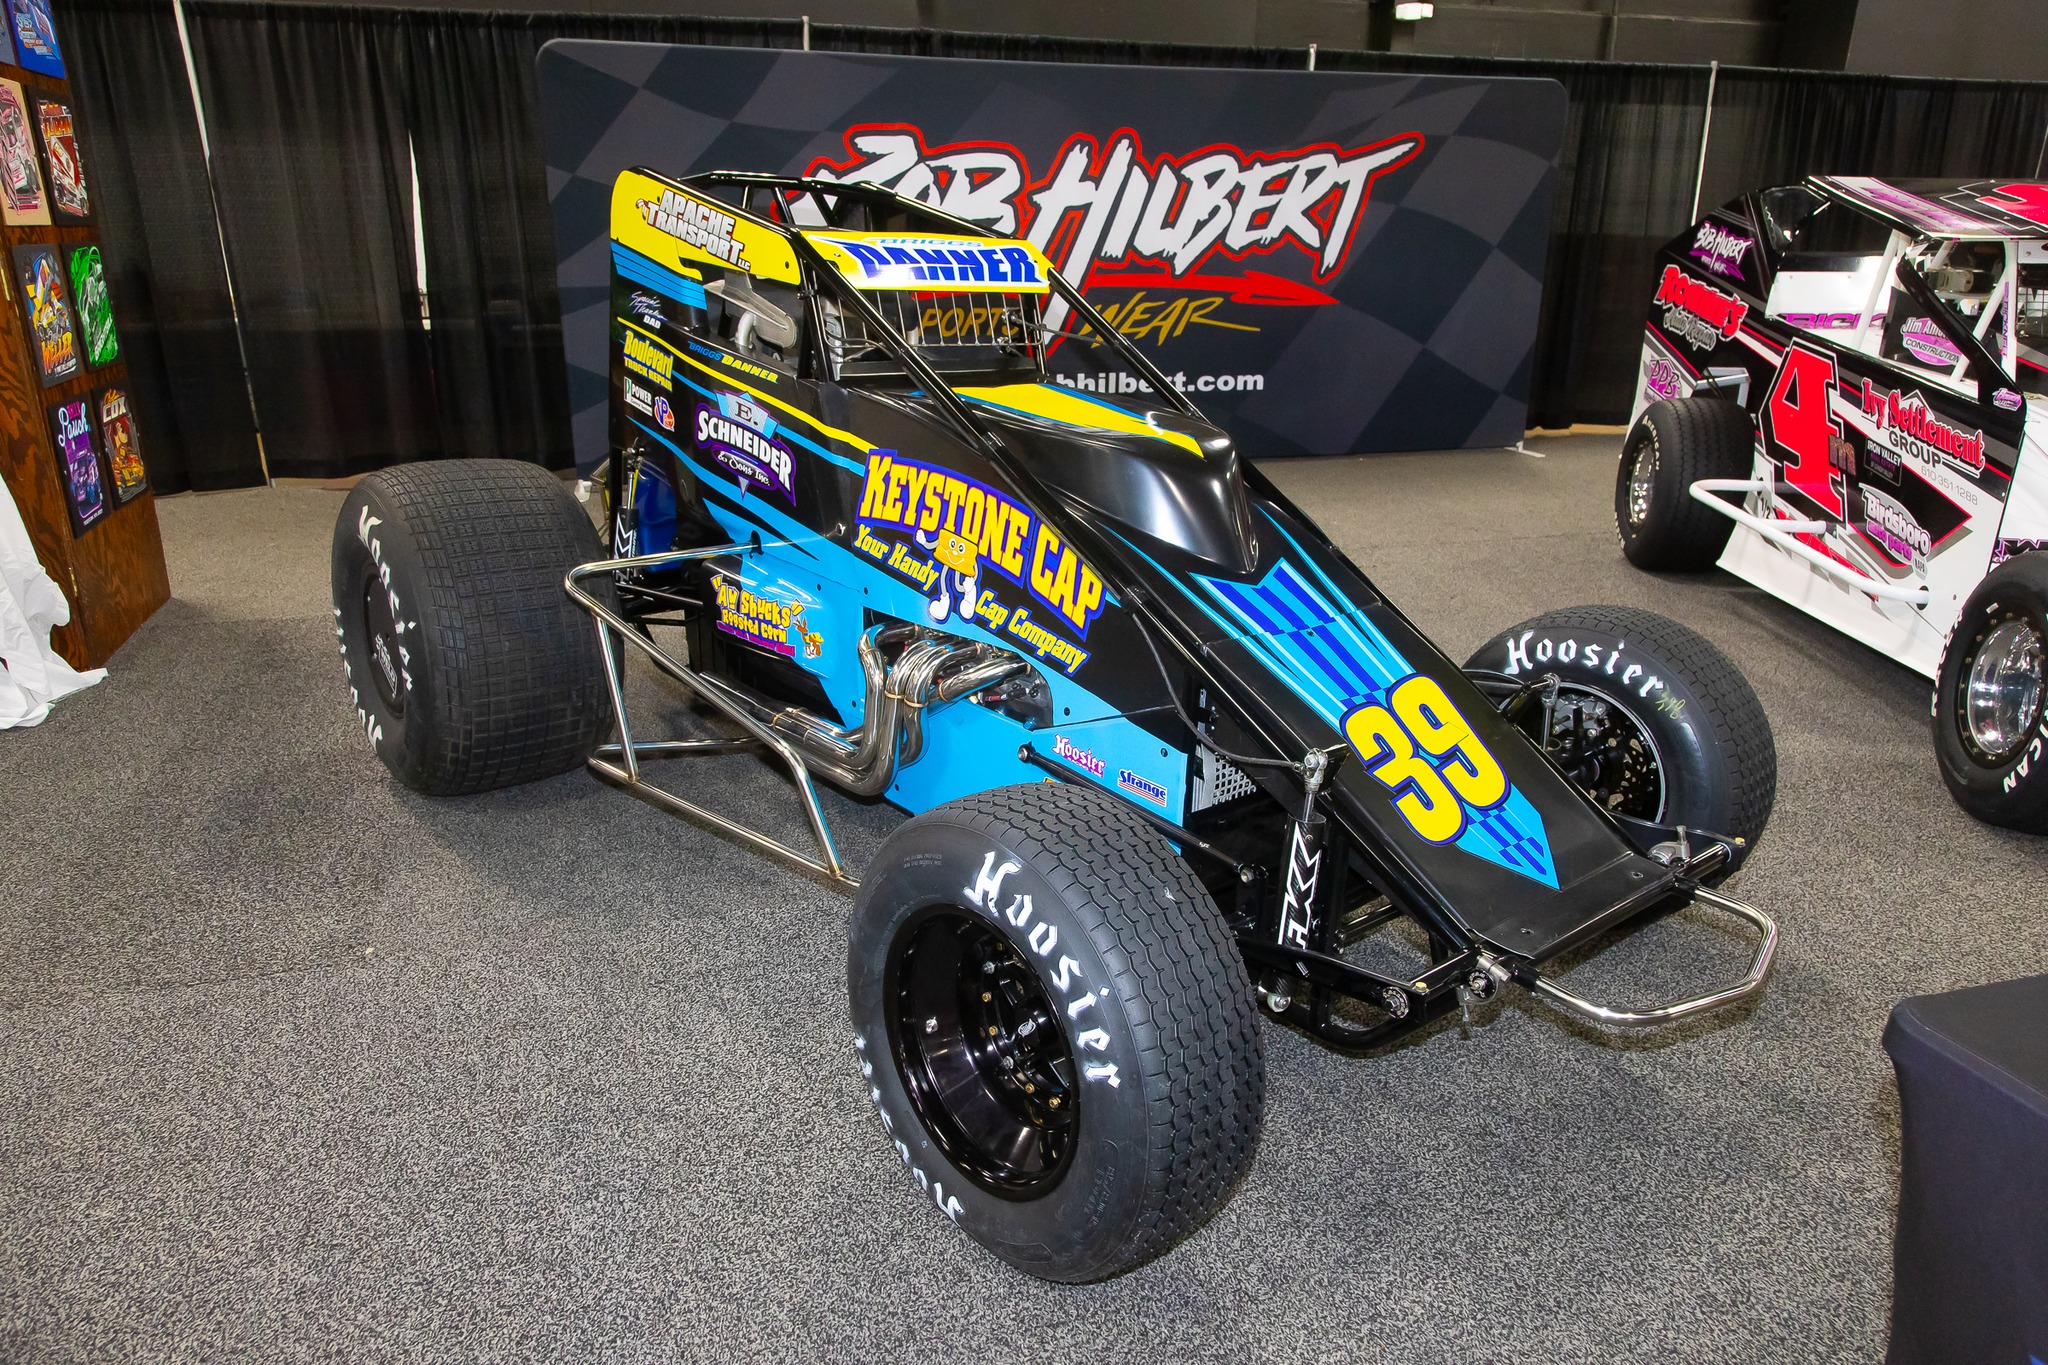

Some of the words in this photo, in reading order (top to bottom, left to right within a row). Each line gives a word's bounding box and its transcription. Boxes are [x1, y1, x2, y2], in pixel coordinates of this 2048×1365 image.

[646, 200, 745, 265] TRANSPORT
[737, 258, 751, 271] LLC
[660, 189, 736, 242] APACHE
[872, 238, 984, 249] BRIGGS
[1033, 139, 1418, 342] HILBERT
[842, 244, 1044, 284] DANNER
[643, 315, 661, 329] DAD
[1078, 290, 1261, 349] WEAR
[1902, 318, 1922, 333] Jim
[41, 332, 75, 376] WELLER
[624, 331, 674, 379] Boulevard
[688, 341, 722, 361] BRIGGS
[721, 355, 779, 384] DANNER
[1906, 338, 1959, 364] CONSTRUCTION
[624, 357, 649, 378] TRUCK
[648, 370, 673, 391] REPAIR
[631, 383, 652, 406] POWER
[102, 396, 127, 424] COX
[1862, 379, 1887, 430] Ivy
[1888, 389, 1983, 468] Settlement
[697, 411, 792, 492] SCHNEIDER
[1867, 439, 1881, 456] IRON
[1881, 446, 1901, 467] VALLEY
[1889, 430, 1943, 467] GROUP
[729, 456, 753, 476] Sons
[755, 469, 771, 486] Inc.
[859, 455, 1031, 577] KEYSTONE
[1030, 522, 1104, 630] CAP
[1864, 489, 1931, 556] Birdsboro
[854, 523, 889, 559] Your
[887, 542, 940, 590] Handy
[975, 592, 1010, 629] Cap
[1007, 608, 1088, 674] Company
[1503, 630, 1665, 699] Hoosier
[1051, 733, 1106, 775] Hoosier
[1341, 674, 1511, 847] 39
[1119, 770, 1166, 800] Strange
[963, 850, 1121, 1090] Hoosier
